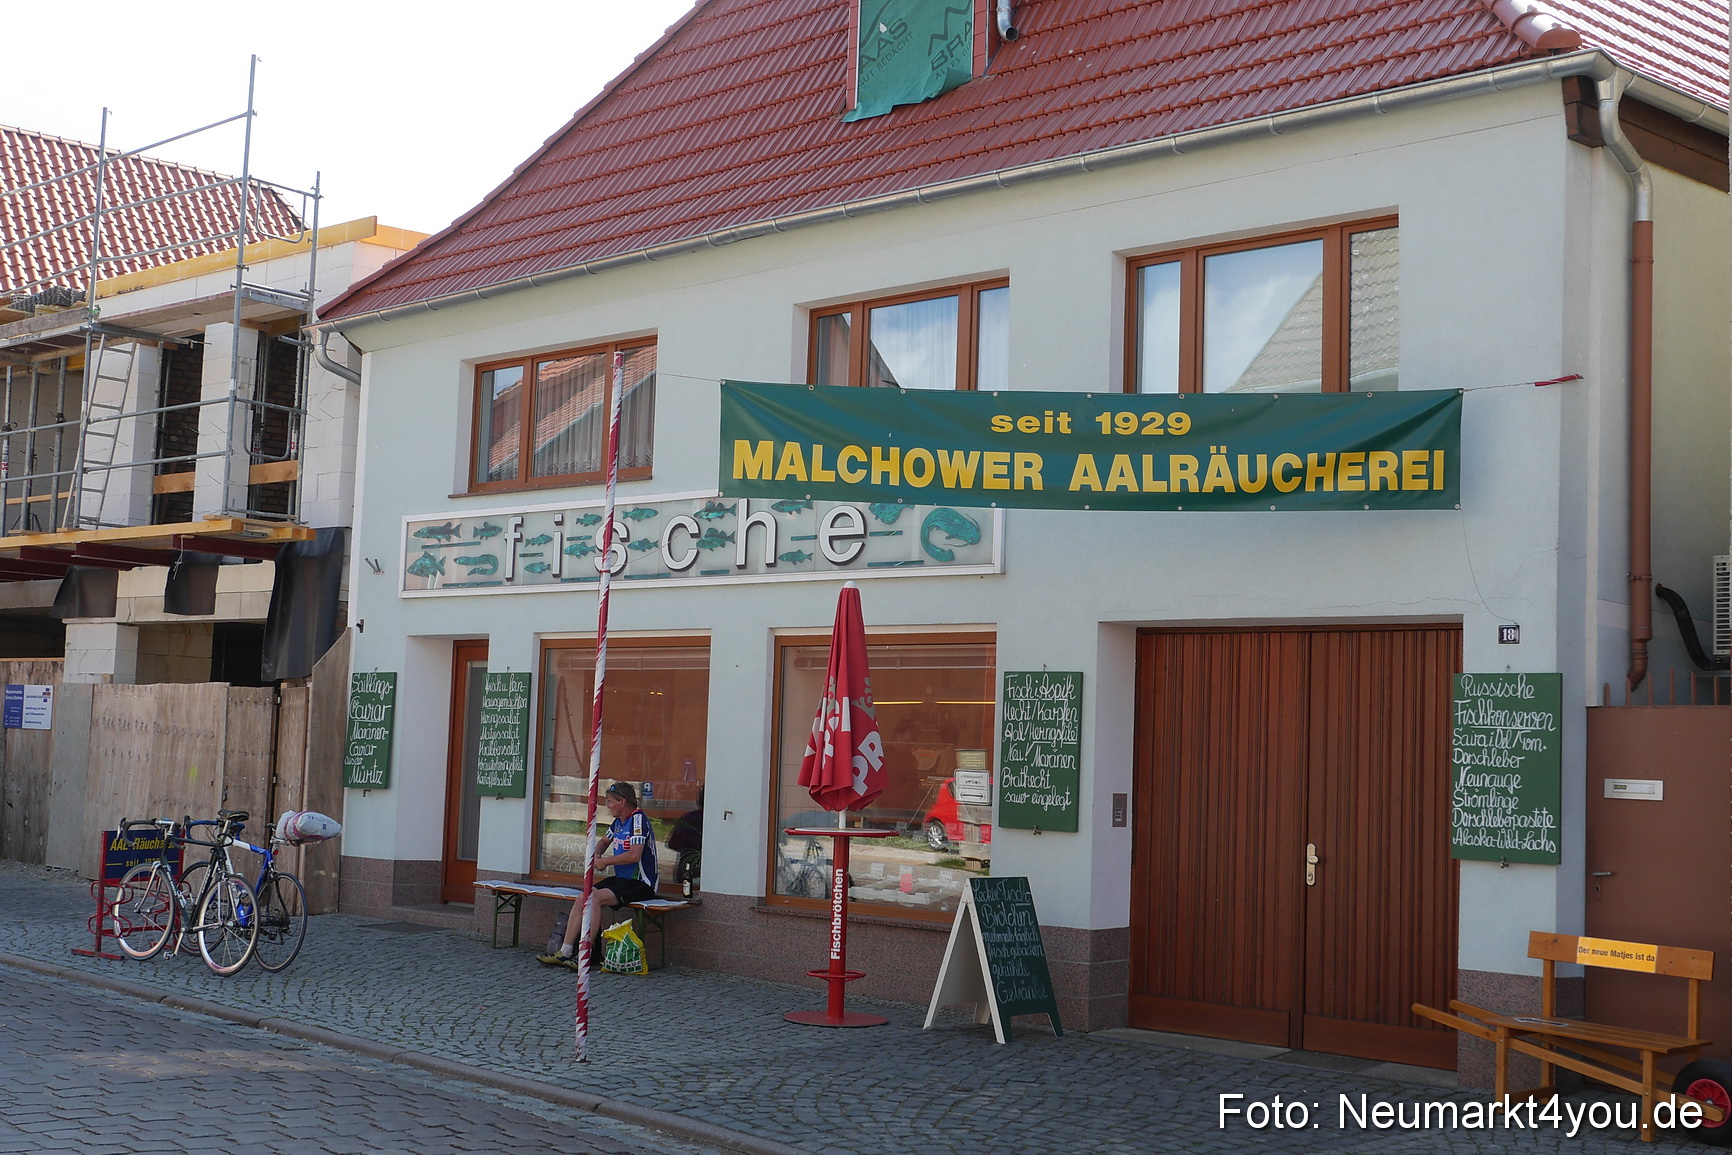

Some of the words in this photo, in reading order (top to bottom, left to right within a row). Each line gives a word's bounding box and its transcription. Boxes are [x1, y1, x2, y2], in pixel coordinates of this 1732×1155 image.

[876, 31, 914, 71] BEDACHT
[990, 410, 1073, 435] seit
[1094, 411, 1192, 436] 1929
[732, 439, 1044, 492] MALCHOWER
[1068, 445, 1445, 494] AALRÄUCHEREI
[504, 497, 868, 582] fische
[1503, 628, 1515, 641] 18
[1005, 674, 1034, 699] Fisch
[1039, 673, 1077, 704] Aspik
[1460, 672, 1535, 699] Russische
[349, 695, 393, 722] Caviar
[1454, 698, 1556, 732] Fischkonserven
[1452, 747, 1525, 769] Dorschleber
[1001, 765, 1052, 790] Brathecht
[1455, 765, 1523, 795] Neunauge
[1004, 791, 1031, 805] sauer
[1031, 784, 1073, 812] eingelegt
[1452, 787, 1520, 815] Strömlinge
[1452, 806, 1557, 831] Dorschleberpastete
[1452, 827, 1557, 854] Alaska-Wild-Lachs
[830, 868, 844, 960] Fischbrötchen
[1578, 945, 1590, 955] Der
[1591, 948, 1609, 957] neue
[1609, 949, 1634, 961] Matjes
[1635, 952, 1645, 961] ist
[1645, 953, 1655, 962] da
